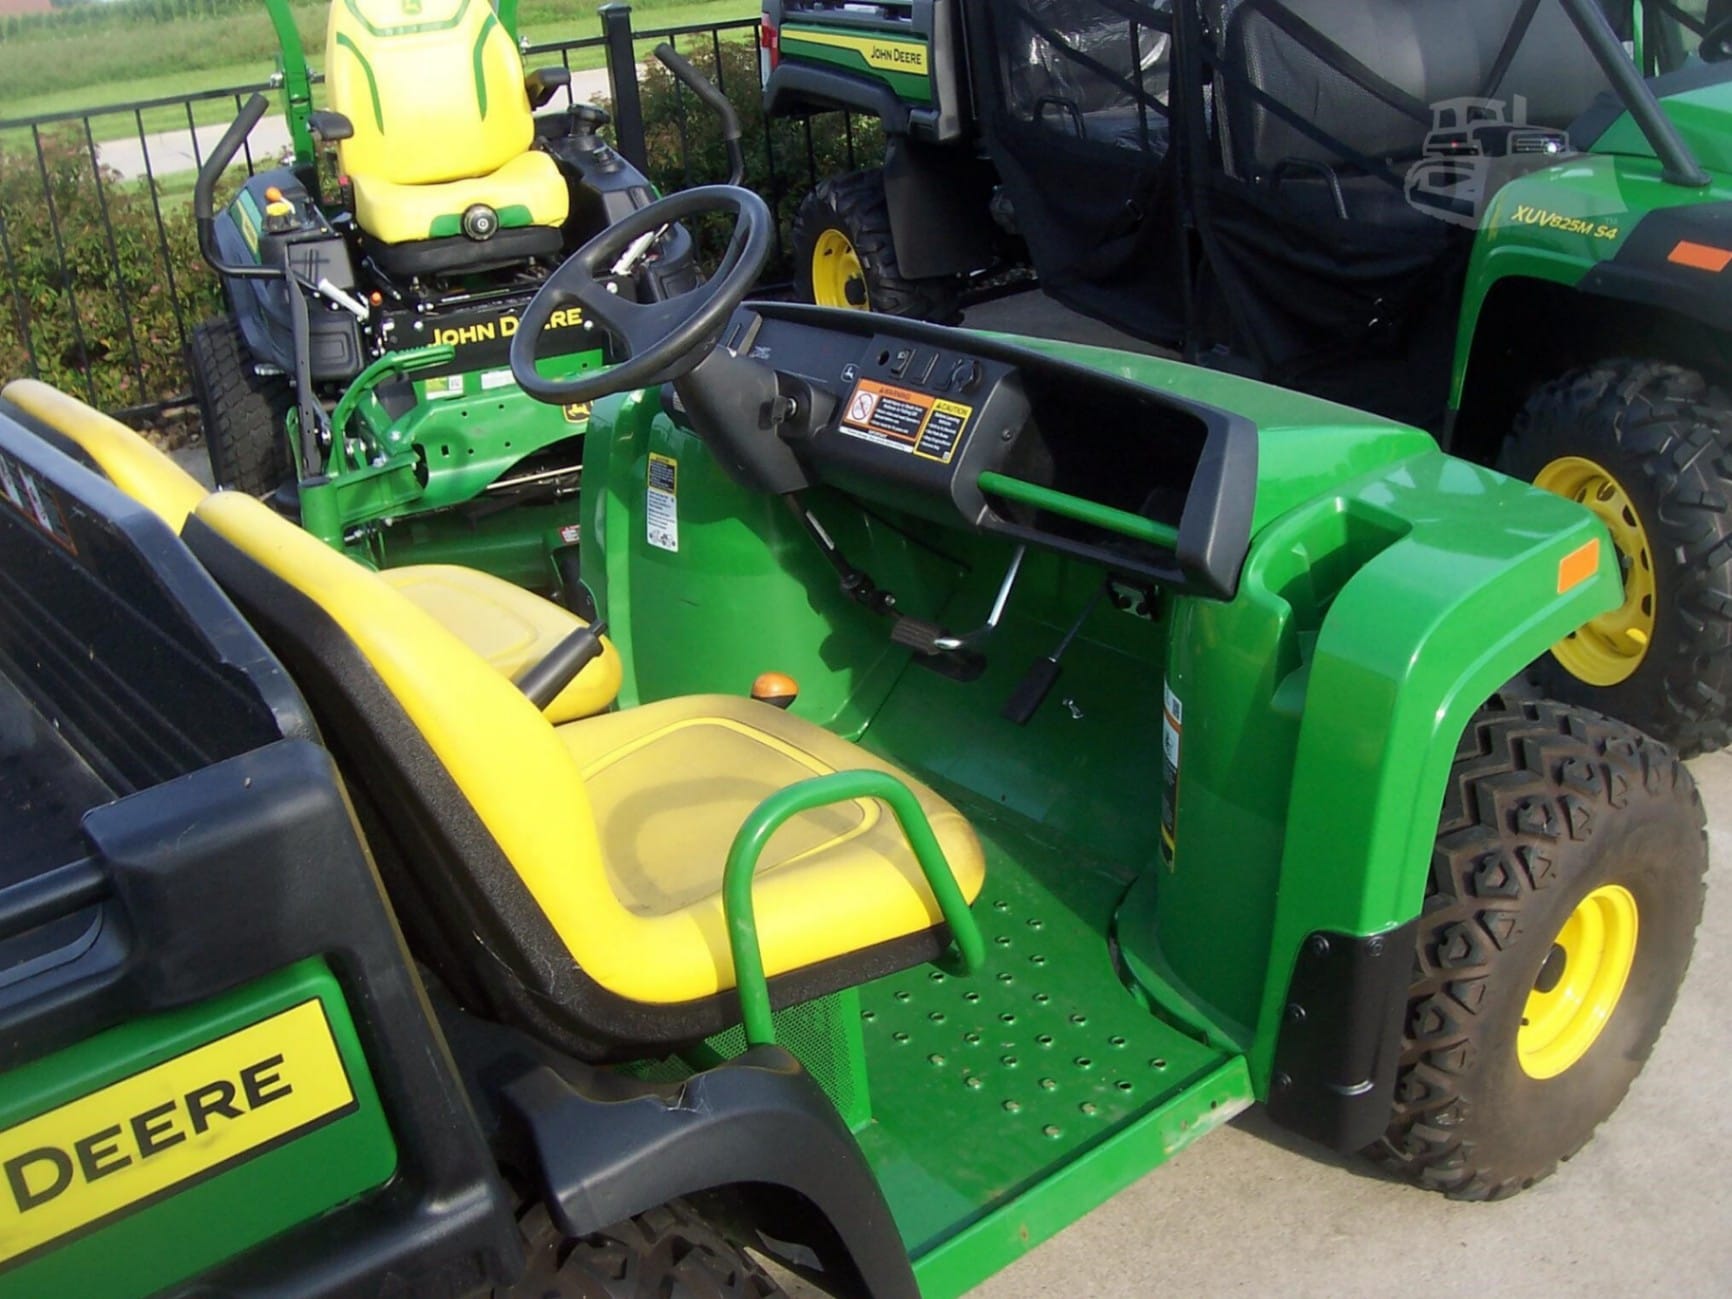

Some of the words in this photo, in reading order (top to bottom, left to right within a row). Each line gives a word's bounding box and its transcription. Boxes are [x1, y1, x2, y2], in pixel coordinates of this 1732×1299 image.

[871, 45, 893, 60] JOHN
[894, 48, 922, 65] DEERE
[1511, 205, 1594, 234] XUV825M
[1594, 225, 1618, 240] S4
[427, 322, 496, 347] JOHN
[500, 307, 583, 337] DRE
[3, 1054, 293, 1214] DEERE
